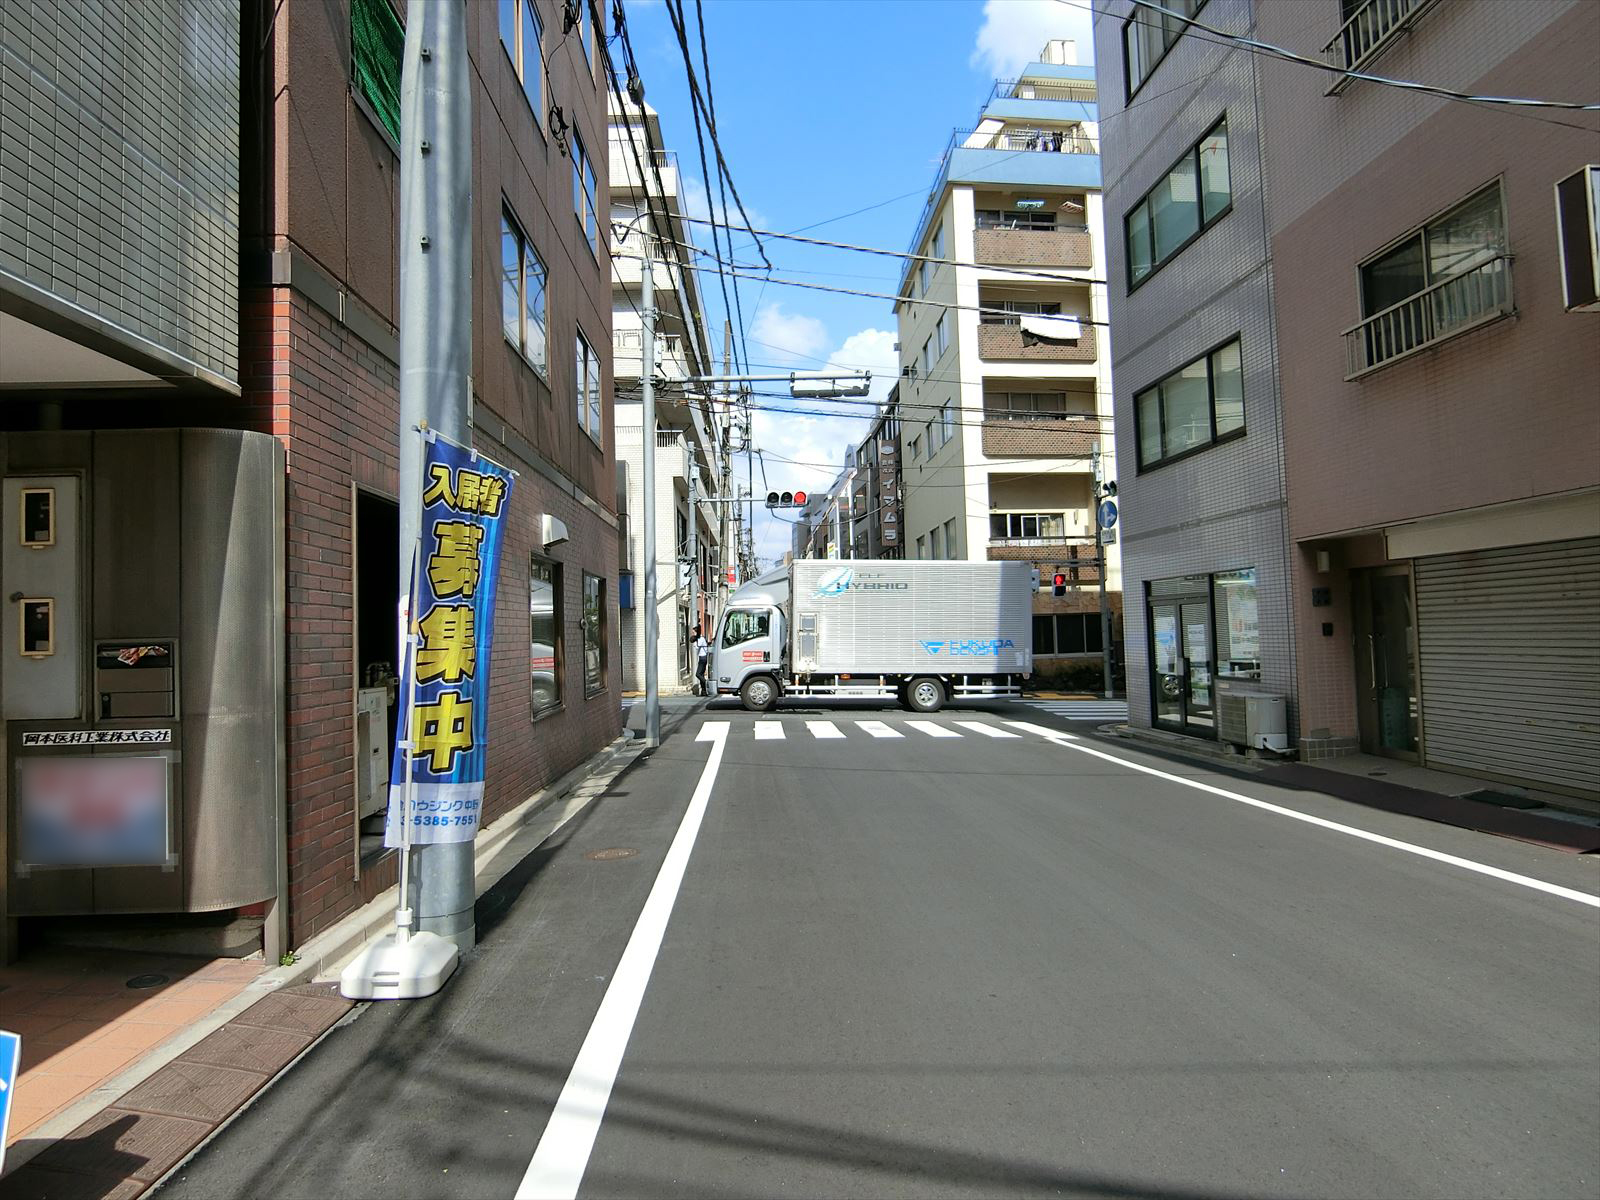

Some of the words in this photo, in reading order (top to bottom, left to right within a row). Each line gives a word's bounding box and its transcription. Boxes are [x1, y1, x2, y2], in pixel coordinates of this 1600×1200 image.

[423, 464, 506, 518] 入居者
[882, 478, 897, 541] イマムラ
[836, 582, 908, 590] HYBRID
[405, 520, 485, 774] 募集中
[24, 730, 170, 744] 岡本医科工業株式会社
